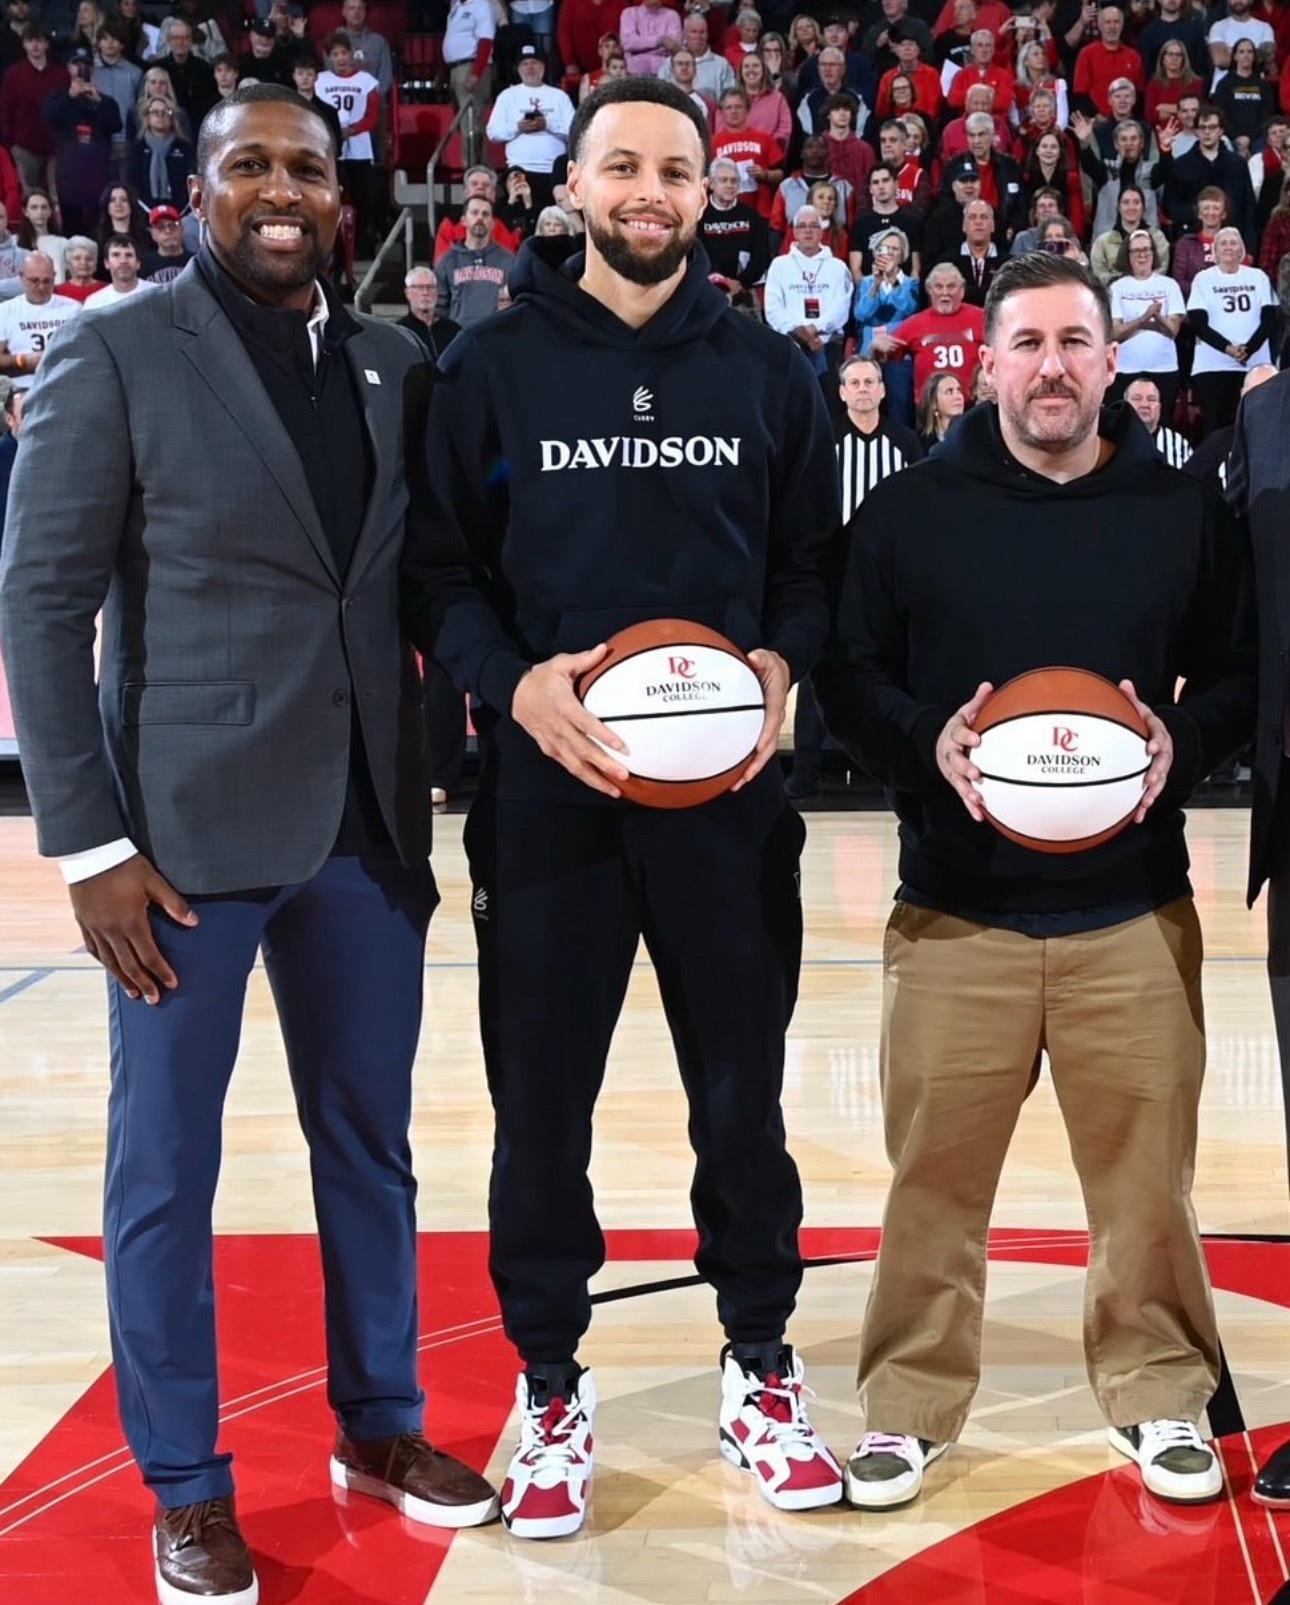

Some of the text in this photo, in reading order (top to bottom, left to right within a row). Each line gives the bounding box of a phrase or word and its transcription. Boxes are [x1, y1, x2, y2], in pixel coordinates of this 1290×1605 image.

[332, 95, 354, 112] 30
[716, 141, 761, 158] DAVIDSON
[454, 265, 505, 286] DAVIDSON
[1222, 294, 1251, 313] 30
[933, 345, 964, 368] 30
[540, 436, 741, 471] DAVIDSON
[668, 656, 697, 679] DC
[646, 681, 721, 698] DAVIDSON
[1052, 726, 1079, 752] DC
[1027, 754, 1101, 767] DAVIDSON
[1041, 766, 1086, 775] COLLEGE
